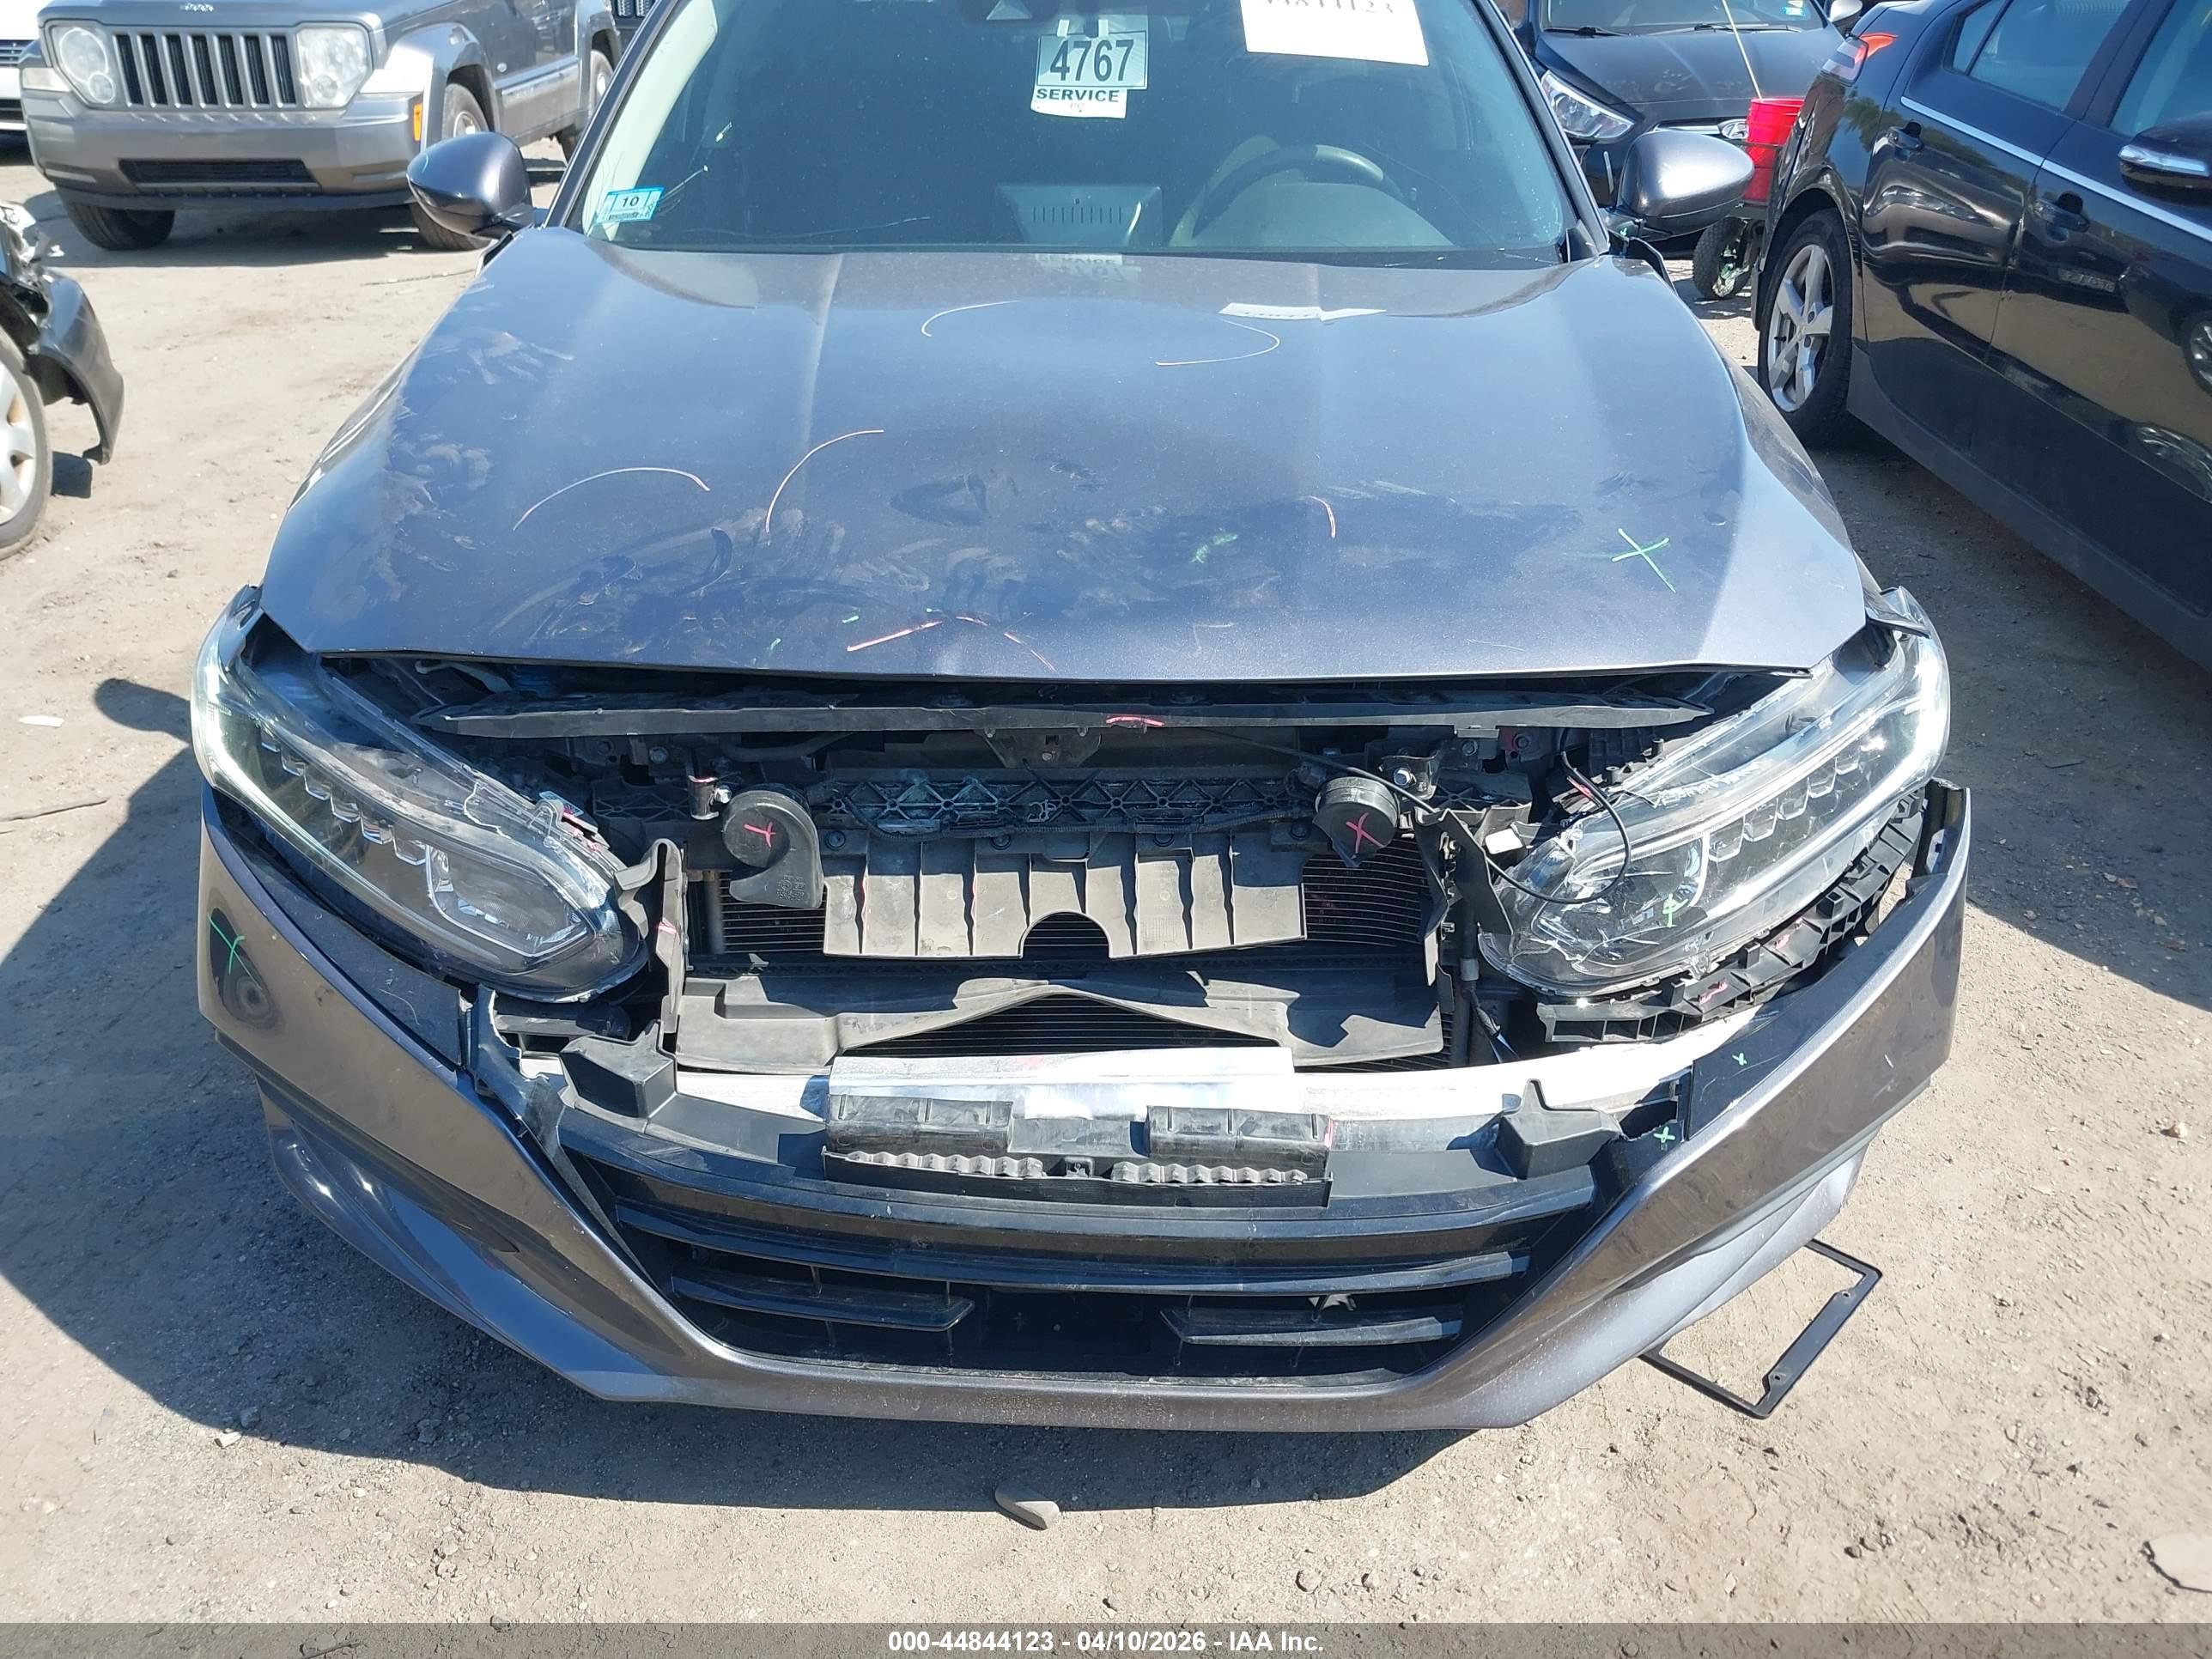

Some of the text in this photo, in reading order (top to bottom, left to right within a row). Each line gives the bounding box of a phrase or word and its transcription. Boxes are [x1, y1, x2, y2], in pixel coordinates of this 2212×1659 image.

[1050, 40, 1134, 81] 4767
[1036, 88, 1120, 102] SERVICE
[623, 197, 640, 207] 10
